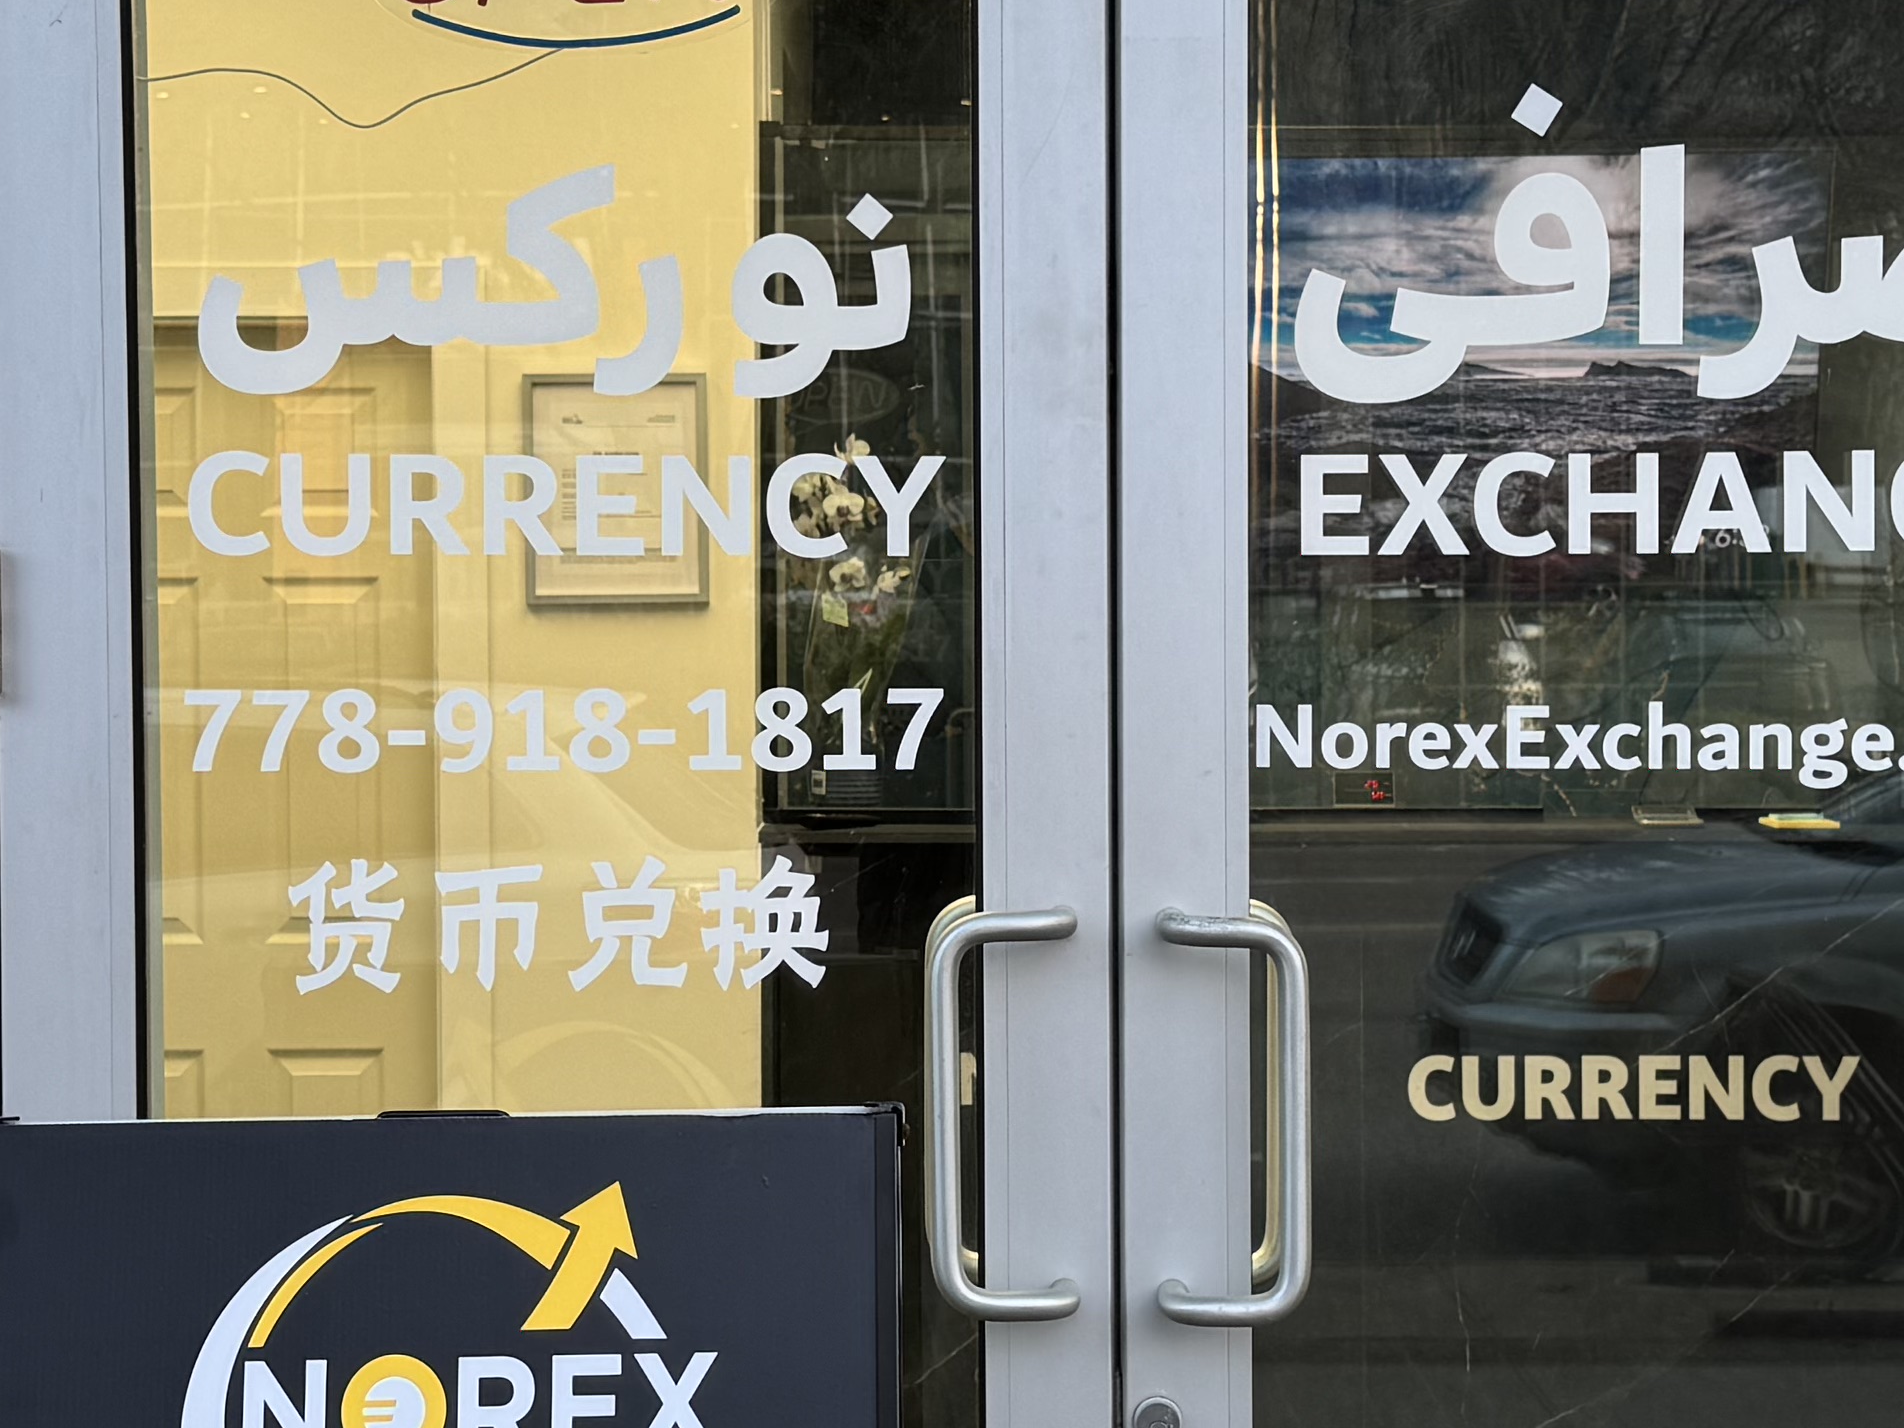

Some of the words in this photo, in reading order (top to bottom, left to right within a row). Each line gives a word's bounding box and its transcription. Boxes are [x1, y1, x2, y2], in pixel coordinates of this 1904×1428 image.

[199, 164, 913, 396] نورکس
[188, 450, 946, 559] CURRENCY
[183, 687, 945, 772] 778-918-1817
[288, 856, 829, 995] 货币兑换
[1407, 1053, 1859, 1123] CURRENCY
